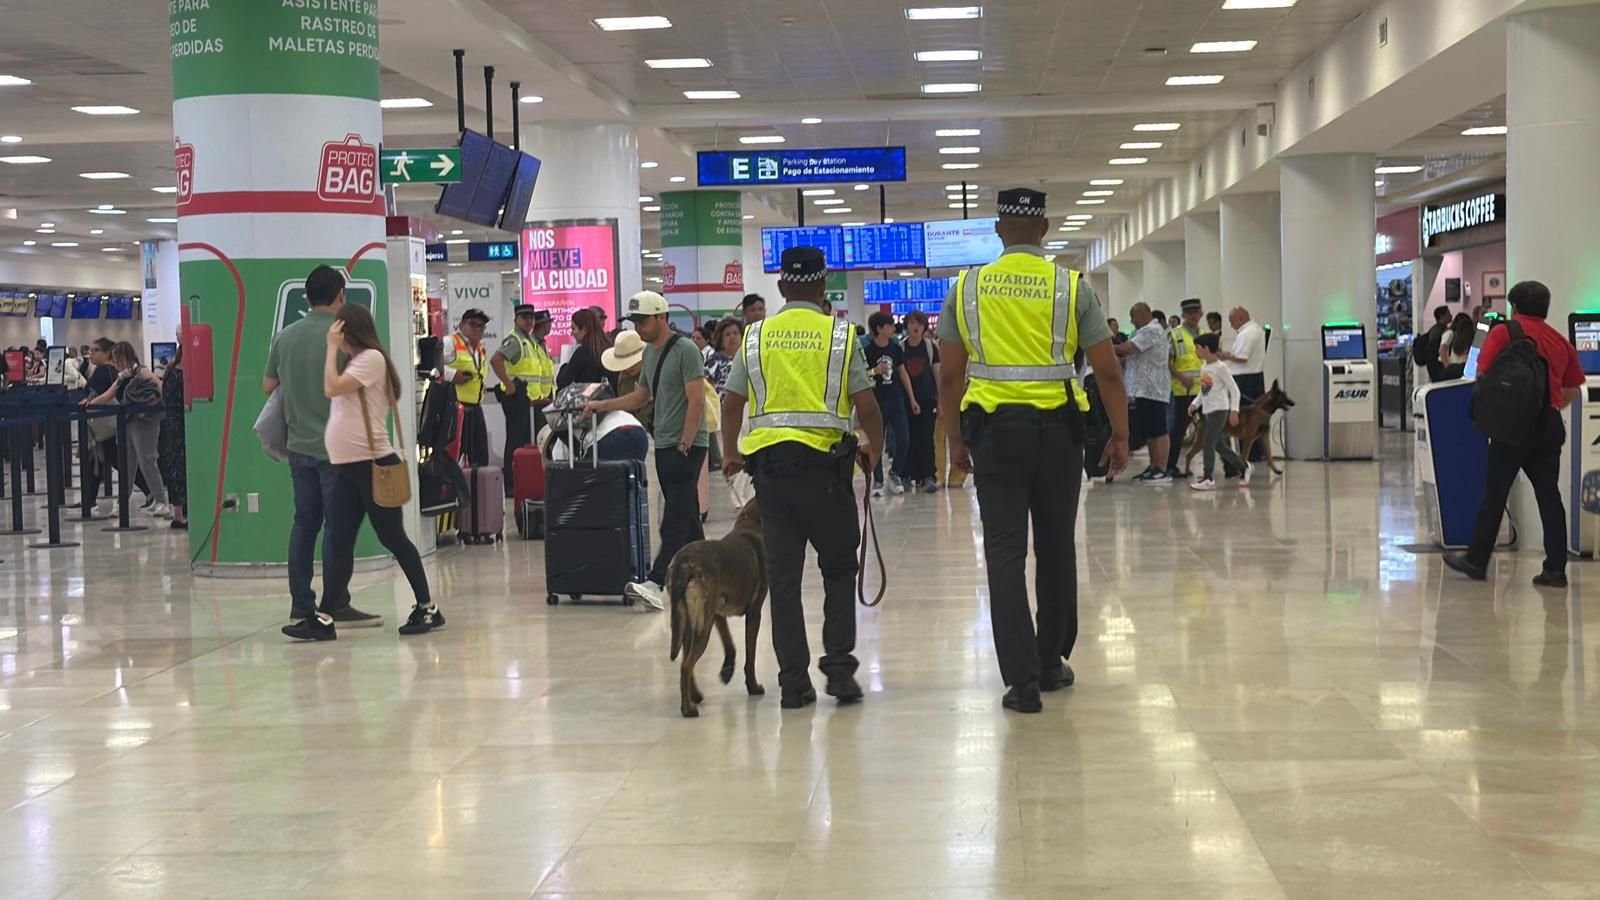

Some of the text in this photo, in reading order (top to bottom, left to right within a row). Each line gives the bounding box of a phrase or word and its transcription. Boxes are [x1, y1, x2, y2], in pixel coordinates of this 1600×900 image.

[179, 0, 210, 12] PARA
[182, 18, 197, 33] DE
[301, 16, 377, 39] RASTREO DE
[269, 36, 345, 54] MALETAS
[328, 150, 374, 167] PROTEC
[783, 158, 808, 167] Parking
[823, 157, 847, 166] Station
[733, 158, 750, 180] E
[783, 165, 875, 177] Pago de Estacionamiento
[325, 166, 373, 194] BAG
[1423, 200, 1465, 249] STARBUCKS
[1466, 193, 1495, 227] COFFEE
[529, 229, 555, 250] NOS
[530, 248, 580, 270] MUEVE
[531, 268, 608, 290] LA CIUDAD
[983, 273, 1048, 287] GUARDIA
[979, 287, 1052, 299] NACIONAL
[767, 330, 822, 340] GUARDIA
[765, 341, 825, 351] NACIONAL
[1334, 389, 1369, 399] ASUR
